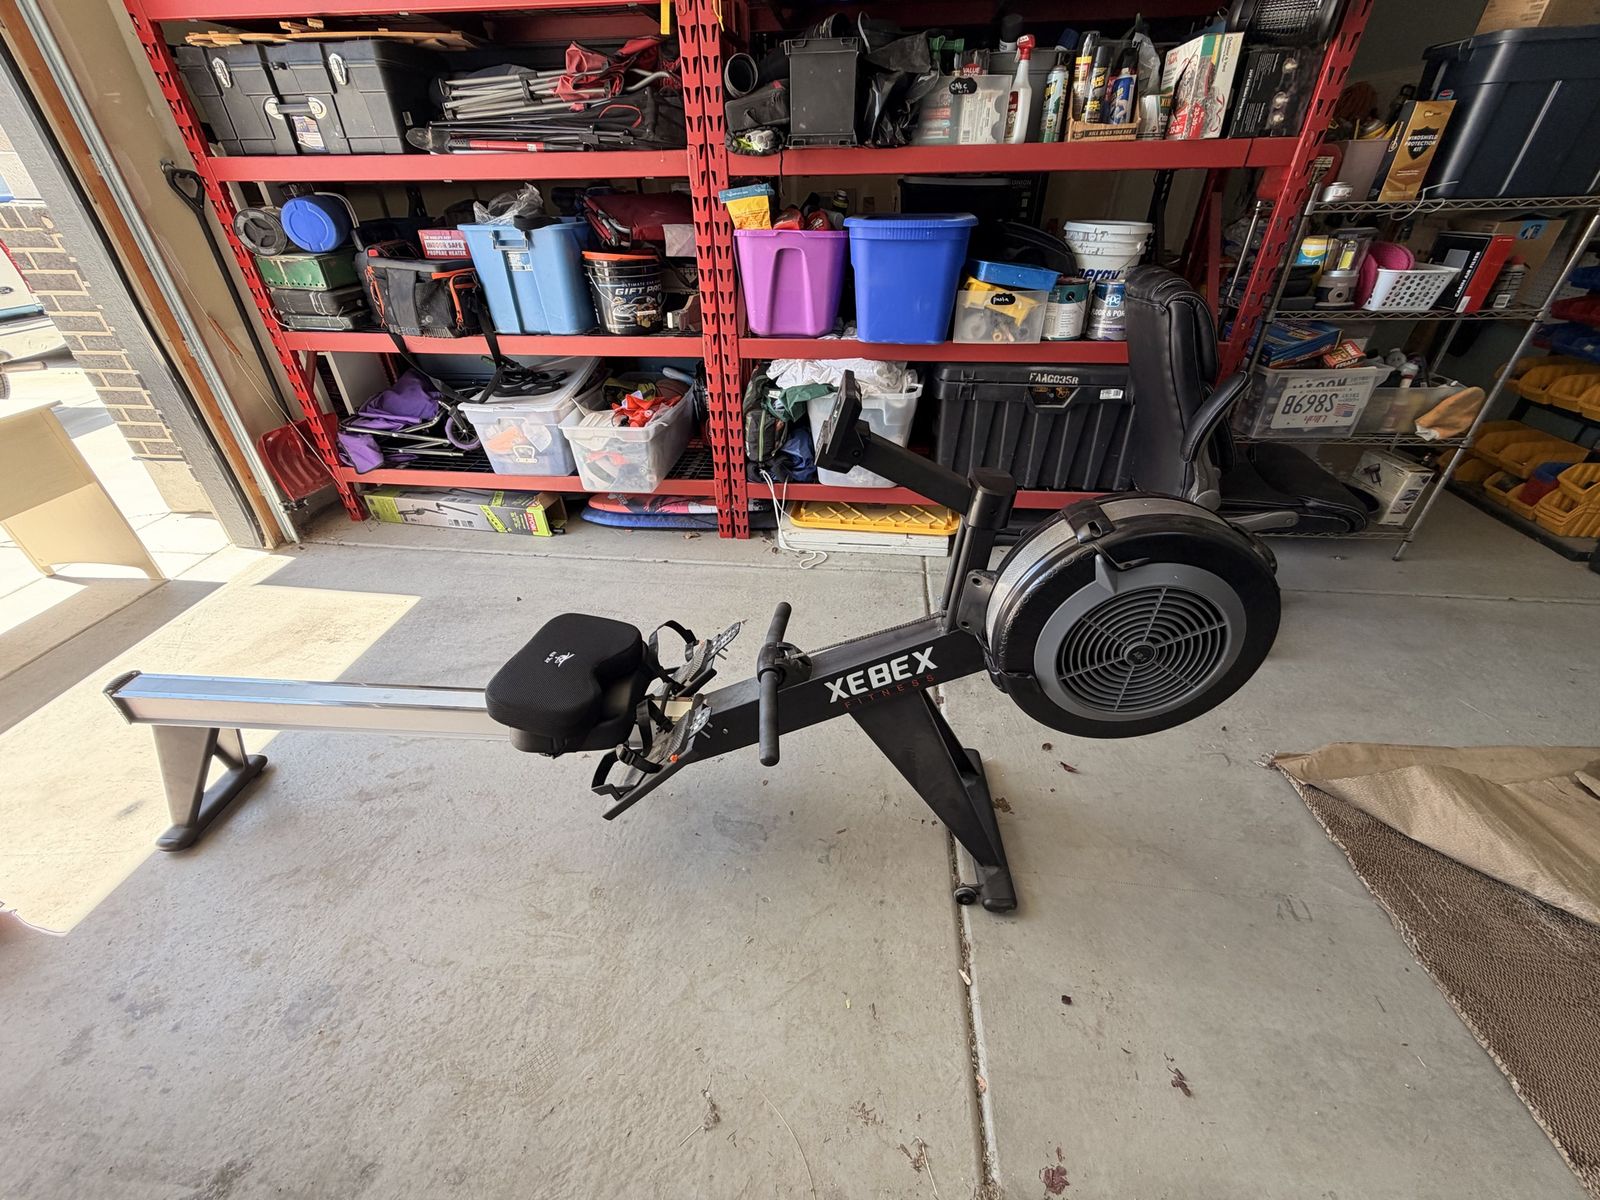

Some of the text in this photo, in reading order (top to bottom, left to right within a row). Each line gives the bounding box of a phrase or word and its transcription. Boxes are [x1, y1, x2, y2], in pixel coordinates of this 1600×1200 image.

[426, 240, 463, 248] INDOOR SAFE
[1455, 251, 1480, 298] CABIN AIR FILTER
[615, 287, 644, 296] GIFT
[1303, 415, 1328, 424] Utah
[823, 646, 938, 704] XEBEX
[844, 674, 936, 710] FITNESS
